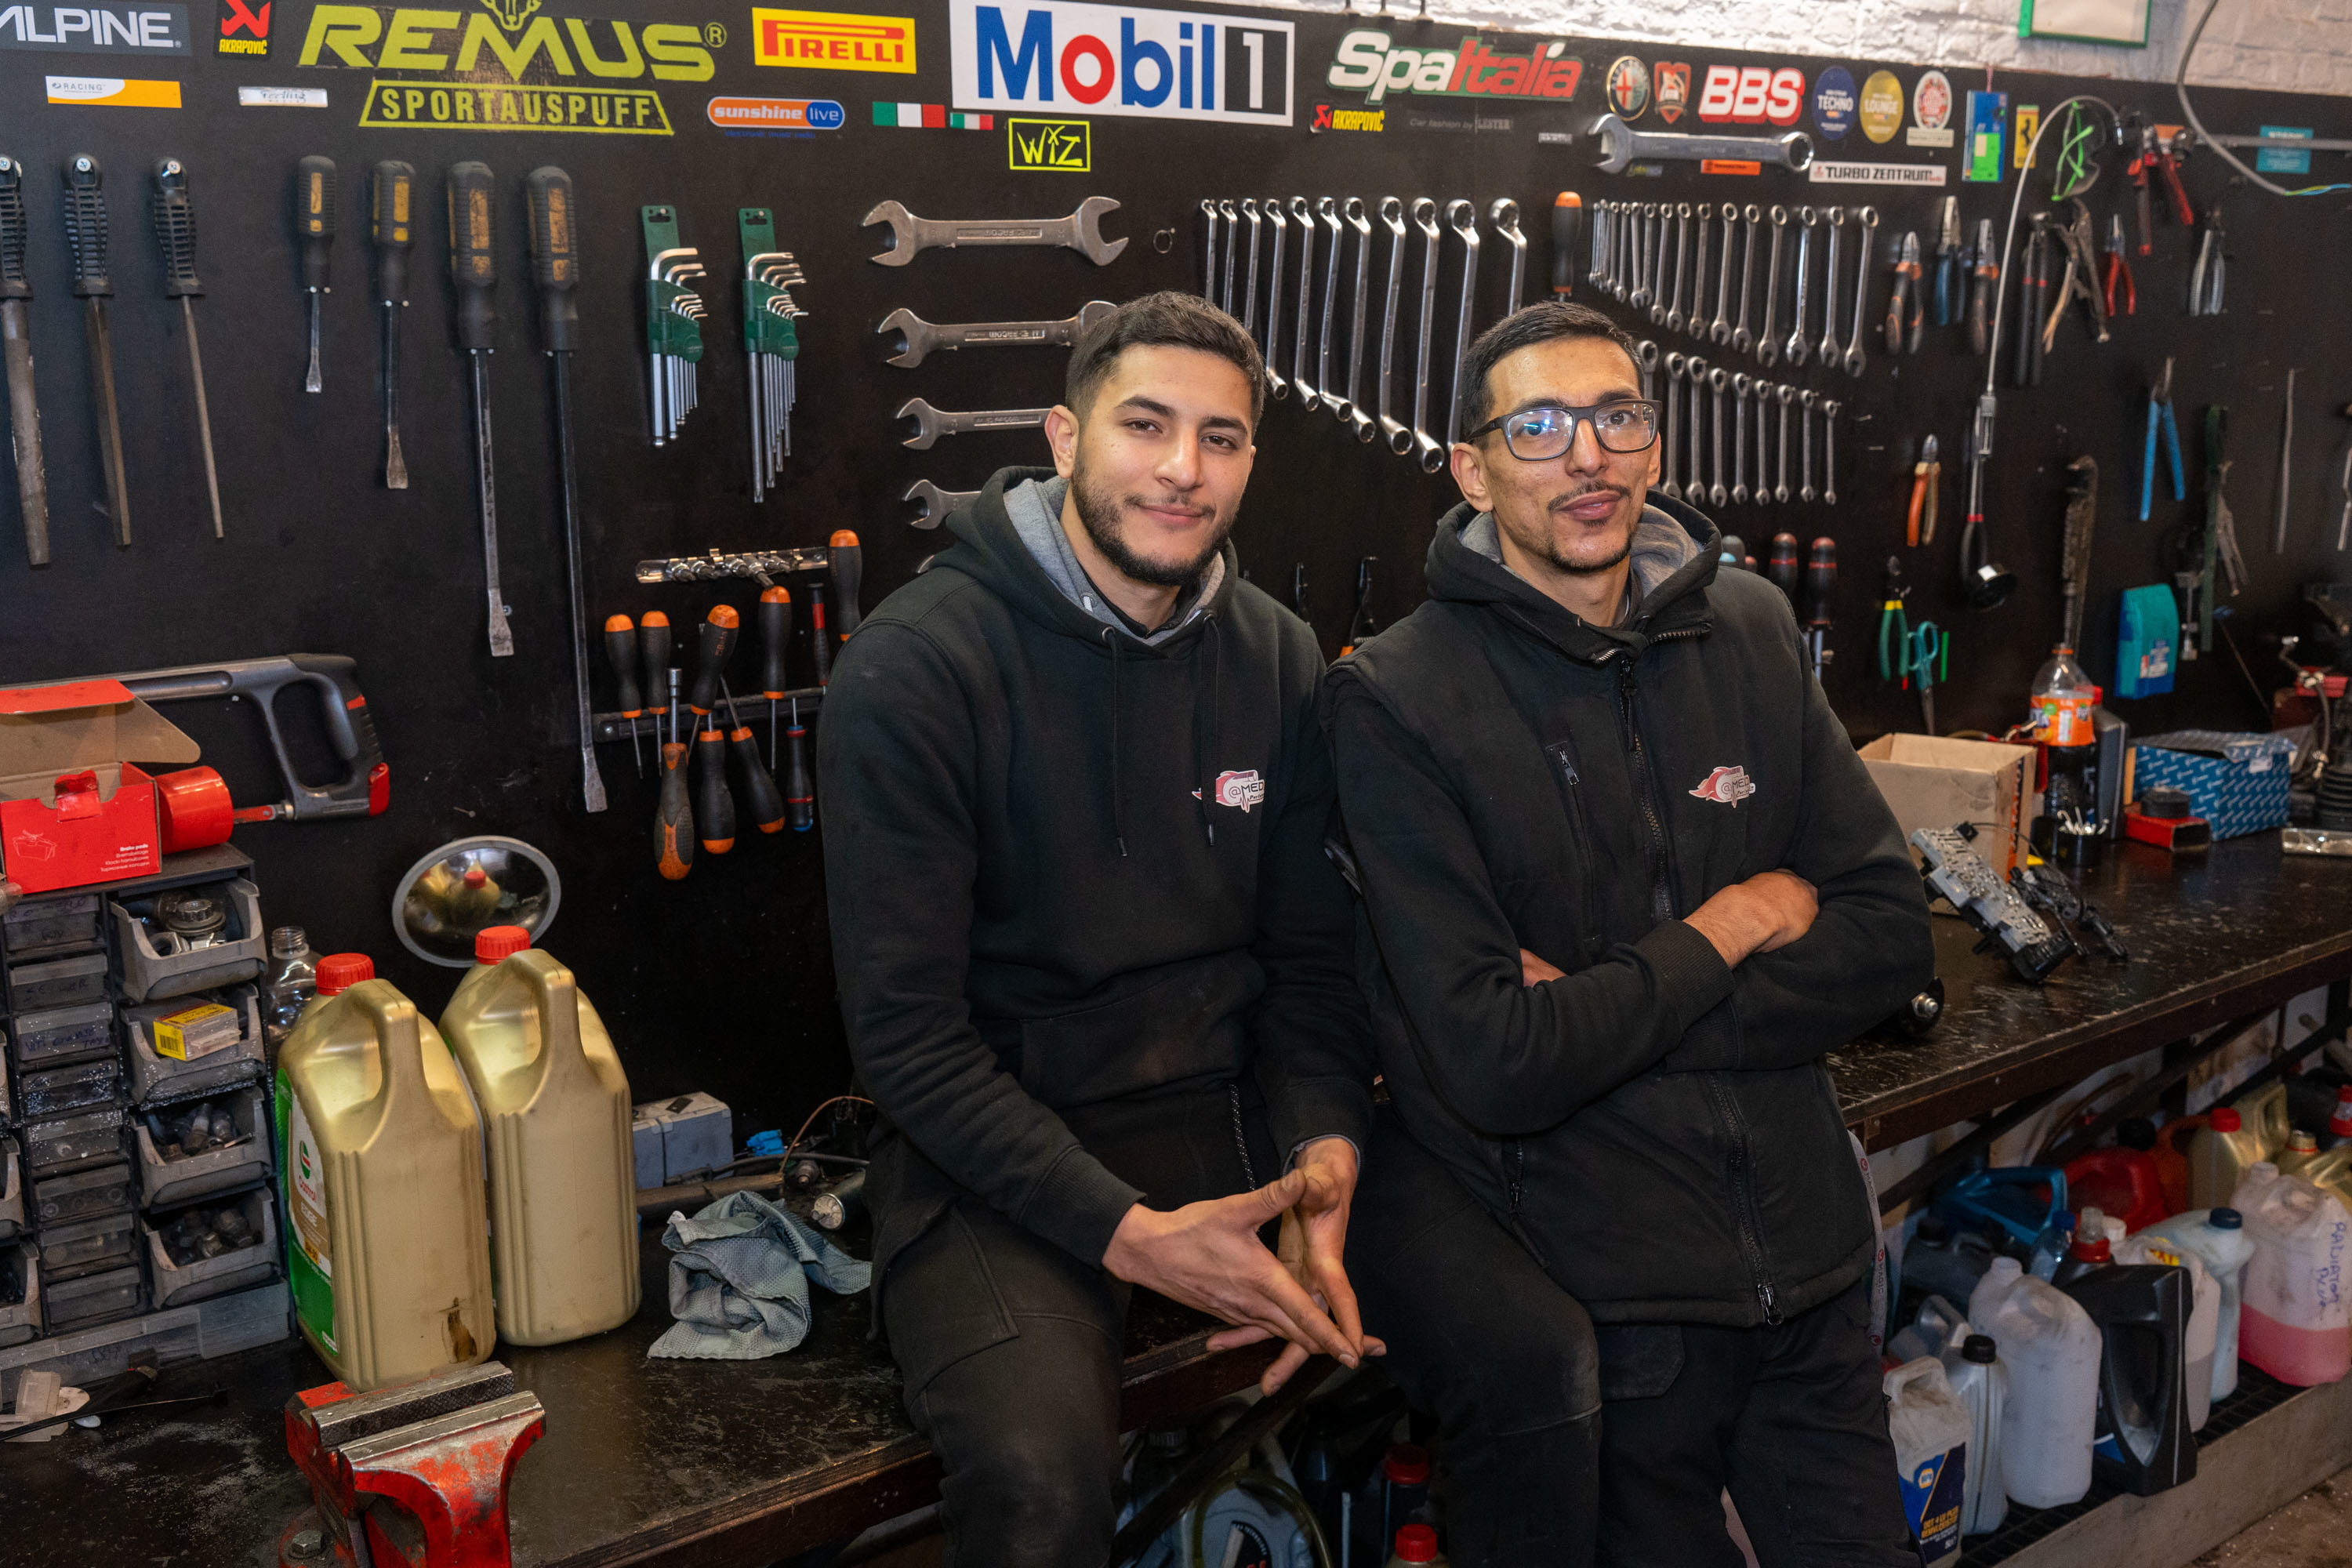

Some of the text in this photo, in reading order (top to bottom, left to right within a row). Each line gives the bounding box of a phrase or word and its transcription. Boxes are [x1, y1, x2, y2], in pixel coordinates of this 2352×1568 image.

[762, 20, 905, 63] PIRELLI
[975, 5, 1264, 109] Mobil 1
[63, 82, 103, 91] RACING
[1698, 66, 1804, 123] BBS
[382, 89, 652, 127] SPORTAUSPUFF
[1817, 95, 1853, 111] TECHNO
[1864, 99, 1899, 115] LOUNGE
[714, 104, 840, 121] sunshine live
[1825, 166, 1870, 180] TURBO
